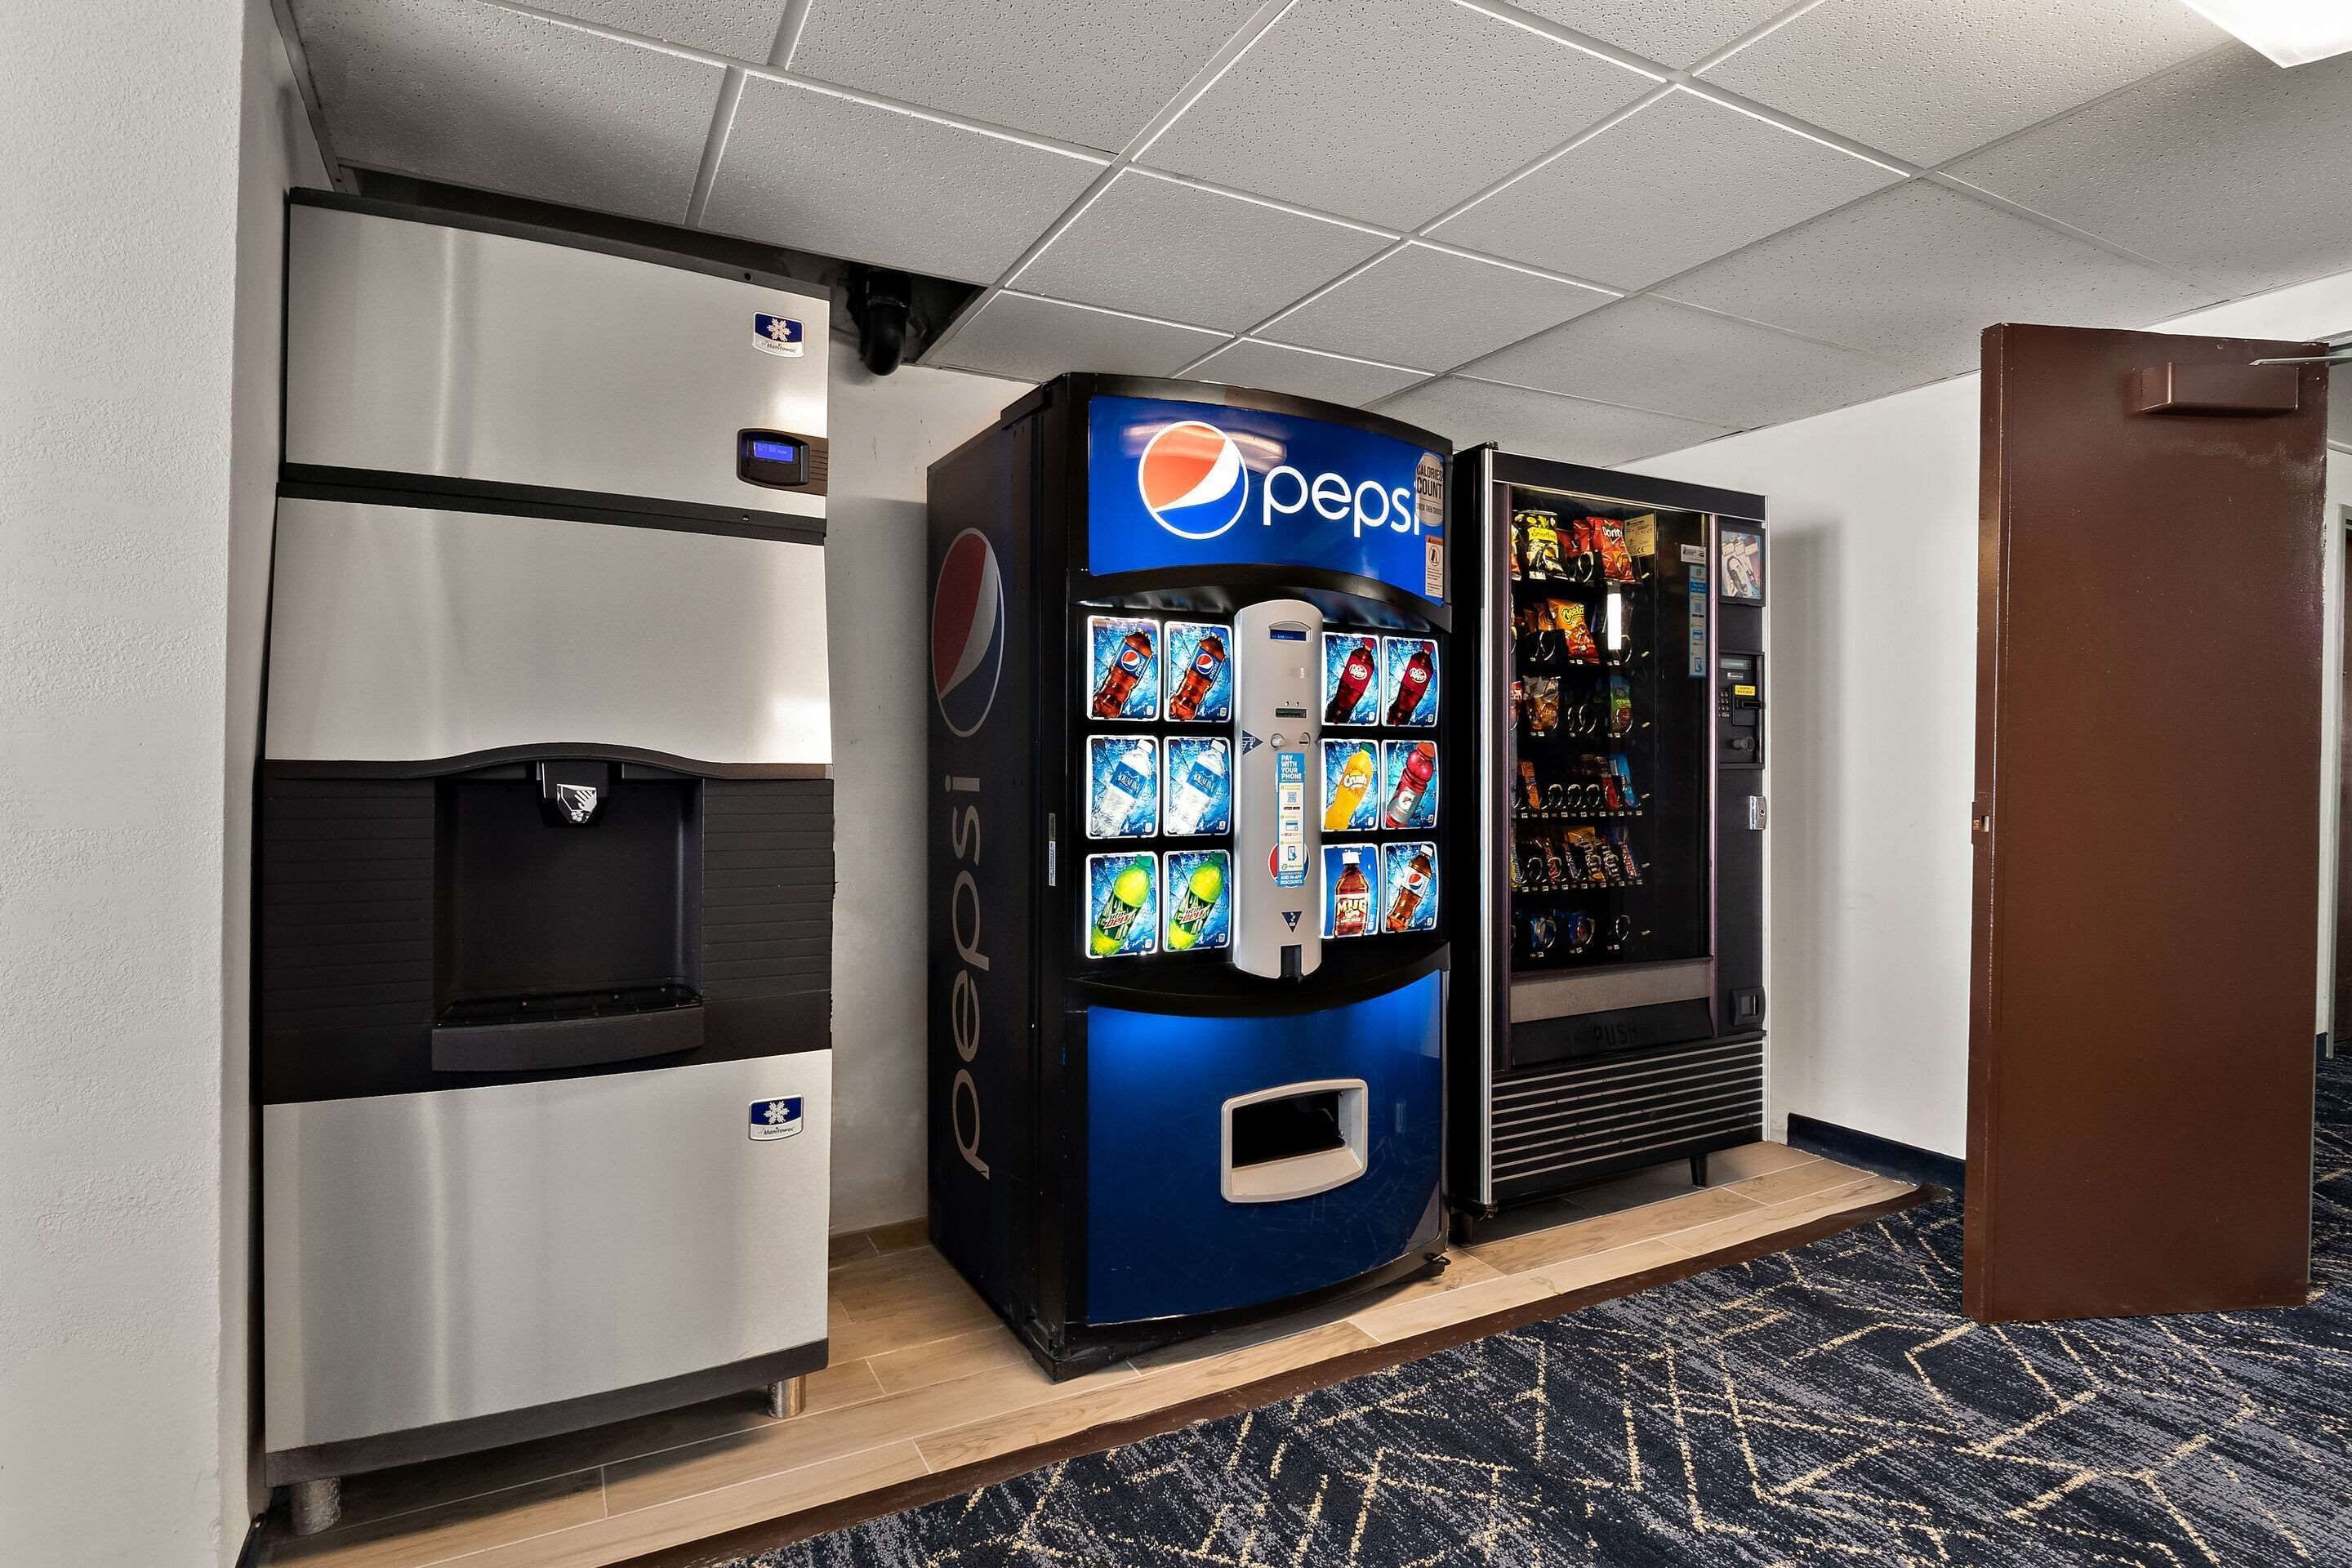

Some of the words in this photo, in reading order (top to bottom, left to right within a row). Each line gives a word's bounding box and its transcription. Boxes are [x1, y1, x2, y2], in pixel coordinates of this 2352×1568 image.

[1417, 464, 1443, 481] CALORIES
[1417, 477, 1442, 498] COUNT
[1263, 465, 1420, 539] pepsi
[1135, 658, 1145, 677] pepsi
[1209, 661, 1219, 679] pepsi
[1337, 898, 1367, 915] MUG
[944, 776, 989, 1179] pepsi
[1592, 1024, 1638, 1048] PUSH
